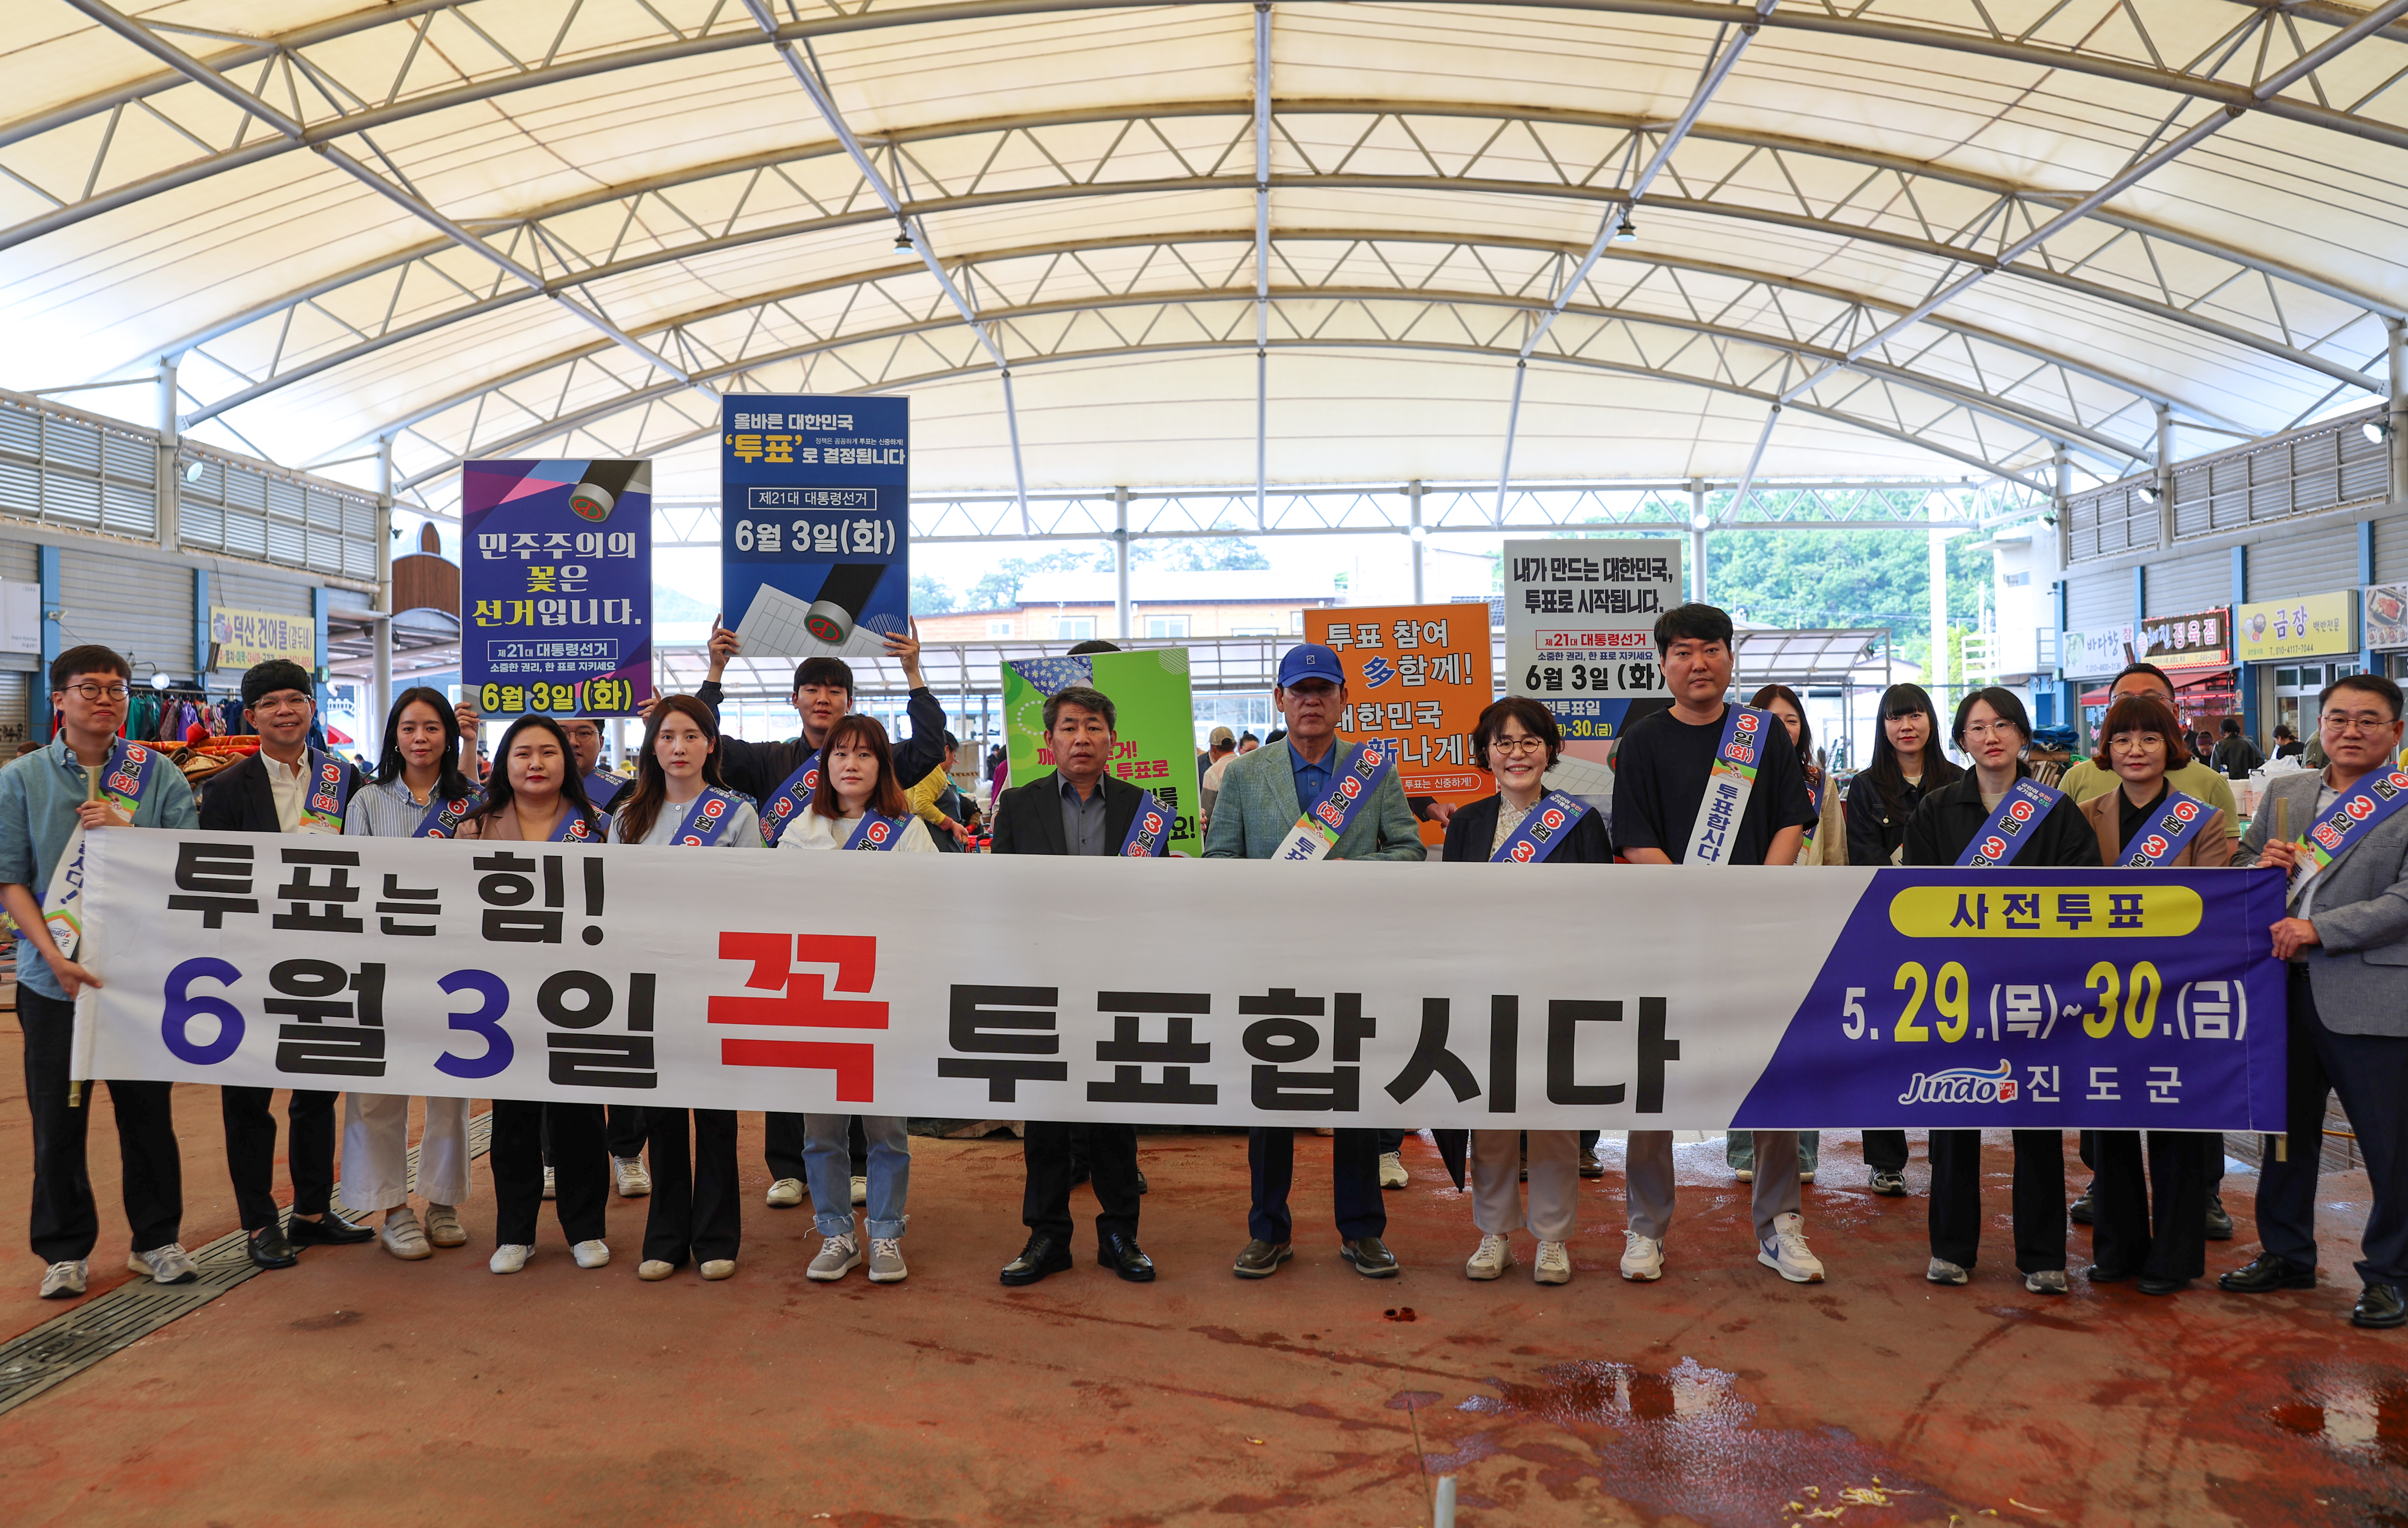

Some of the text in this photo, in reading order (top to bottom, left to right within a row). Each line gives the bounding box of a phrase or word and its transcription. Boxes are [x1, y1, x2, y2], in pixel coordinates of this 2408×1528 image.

[734, 413, 853, 431] 올바른 대한민국
[824, 447, 906, 465] 결정됩니다
[759, 492, 867, 506] 제21대 대통령선거
[478, 532, 636, 560] 민주주의의
[735, 520, 782, 553] 6월
[527, 565, 589, 593] 꽃은
[1513, 557, 1673, 583] 내가 만드는 대한민국,
[1525, 589, 1664, 614] 투표로 시작됩니다.
[472, 598, 641, 627] 선거입니다.
[2272, 604, 2309, 640] 금장
[234, 615, 255, 648] 덕산
[258, 618, 288, 650] 건어물
[1326, 619, 1448, 652] 투표 참여
[2313, 618, 2339, 633] 백반전문
[1545, 633, 1646, 646] 제21대 대통령선거
[498, 643, 607, 658] 제21대 대통령선거
[1538, 651, 1653, 661] 소중한 권리, 한 표로 지키세요
[490, 661, 616, 673] 소중한 권리, 한 표로 지키세요
[1526, 665, 1563, 691] 6월
[482, 683, 524, 711] 6월
[1117, 760, 1170, 781] 투표로
[1405, 777, 1472, 790] 투표는 신중하게!
[2021, 782, 2053, 802] 군민이 주인!
[1555, 793, 1583, 812] 군민이 주인!
[1569, 808, 1580, 818] 진도
[2038, 798, 2050, 808] 진도
[168, 842, 604, 946] 투표는 힘!
[161, 931, 1680, 1113] 6월 3일 꼭 투표합시다
